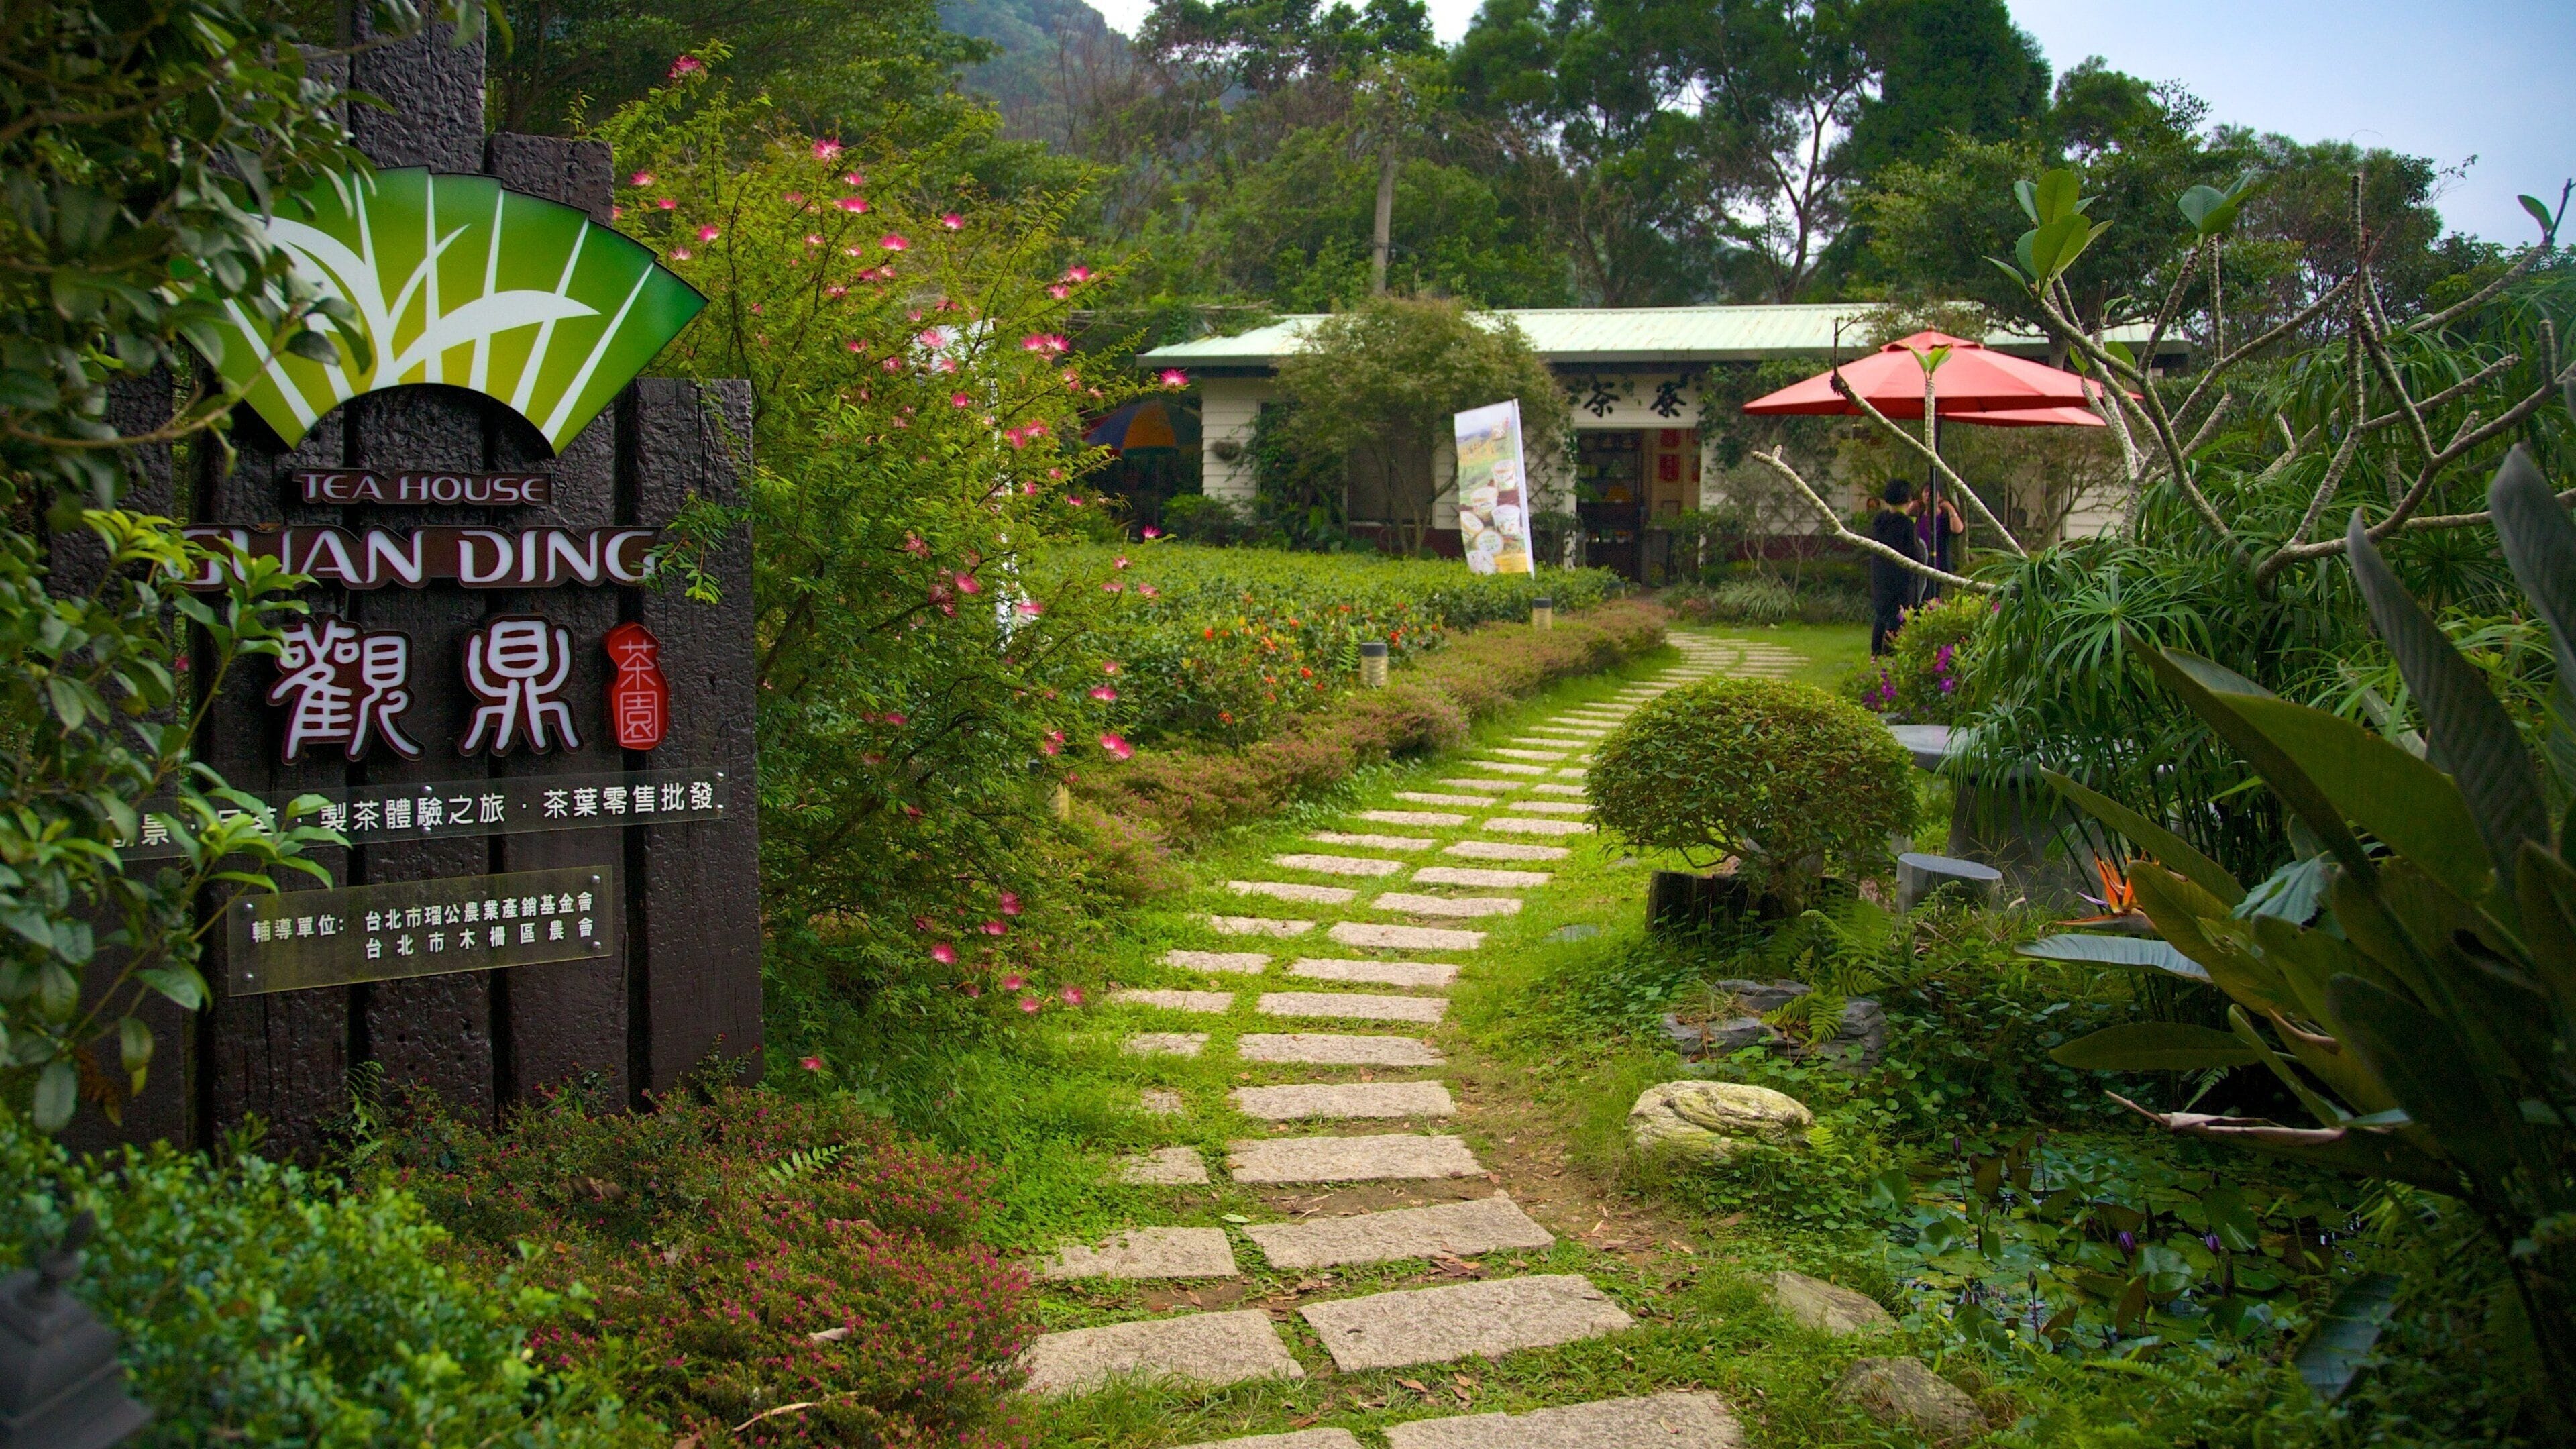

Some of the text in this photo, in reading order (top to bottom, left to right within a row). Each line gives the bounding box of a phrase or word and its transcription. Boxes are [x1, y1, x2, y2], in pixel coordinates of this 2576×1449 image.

[299, 474, 544, 502] TEA HOUSE
[457, 529, 656, 583] DING
[618, 639, 660, 744] 茶園
[543, 781, 714, 819] 茶葉零售批發
[364, 891, 593, 932] 台北市瑠公農業產銷基金會
[365, 916, 594, 959] 台北市木柵區農會
